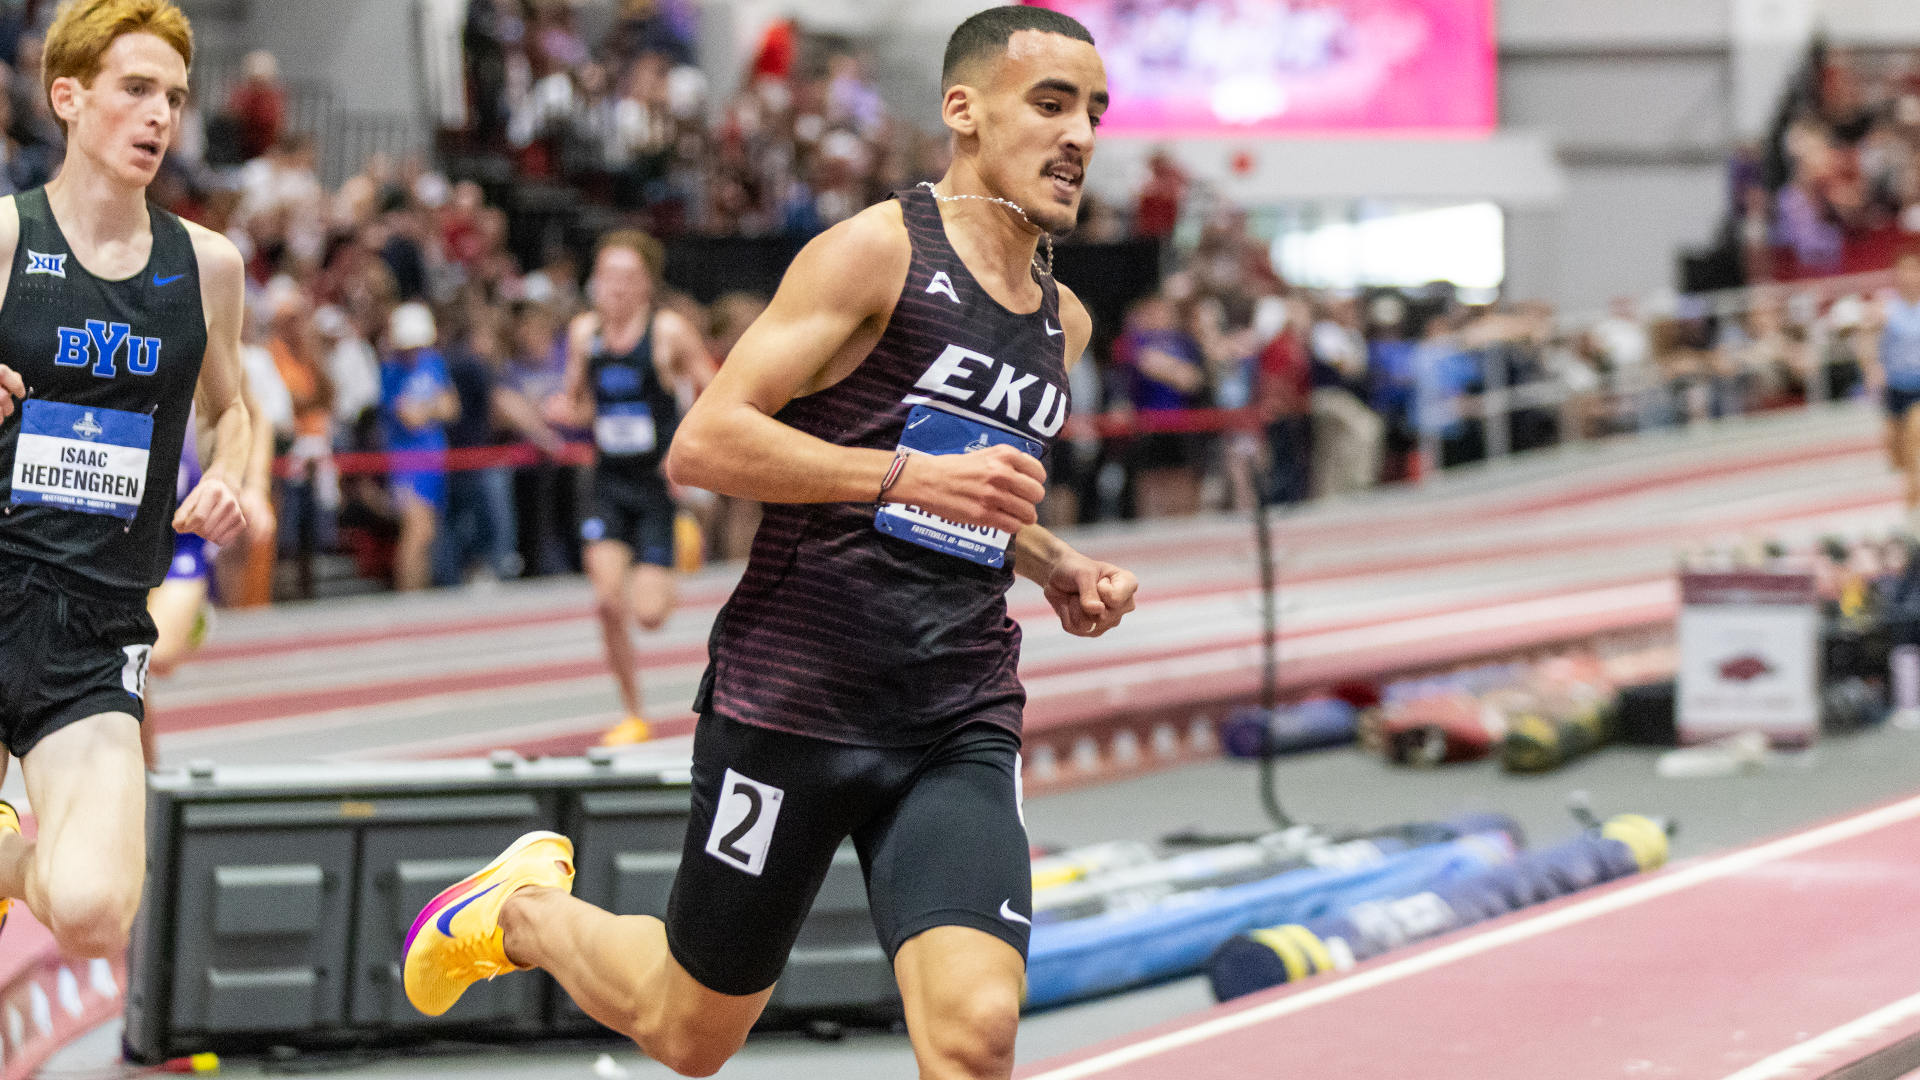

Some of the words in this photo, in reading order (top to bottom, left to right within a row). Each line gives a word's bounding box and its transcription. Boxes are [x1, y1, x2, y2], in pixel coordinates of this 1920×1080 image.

[31, 253, 63, 273] XII
[55, 319, 161, 378] BYU
[913, 343, 1067, 437] EKU
[21, 463, 139, 498] HEDENGREN
[60, 446, 108, 468] ISAAC
[718, 782, 762, 866] 2
